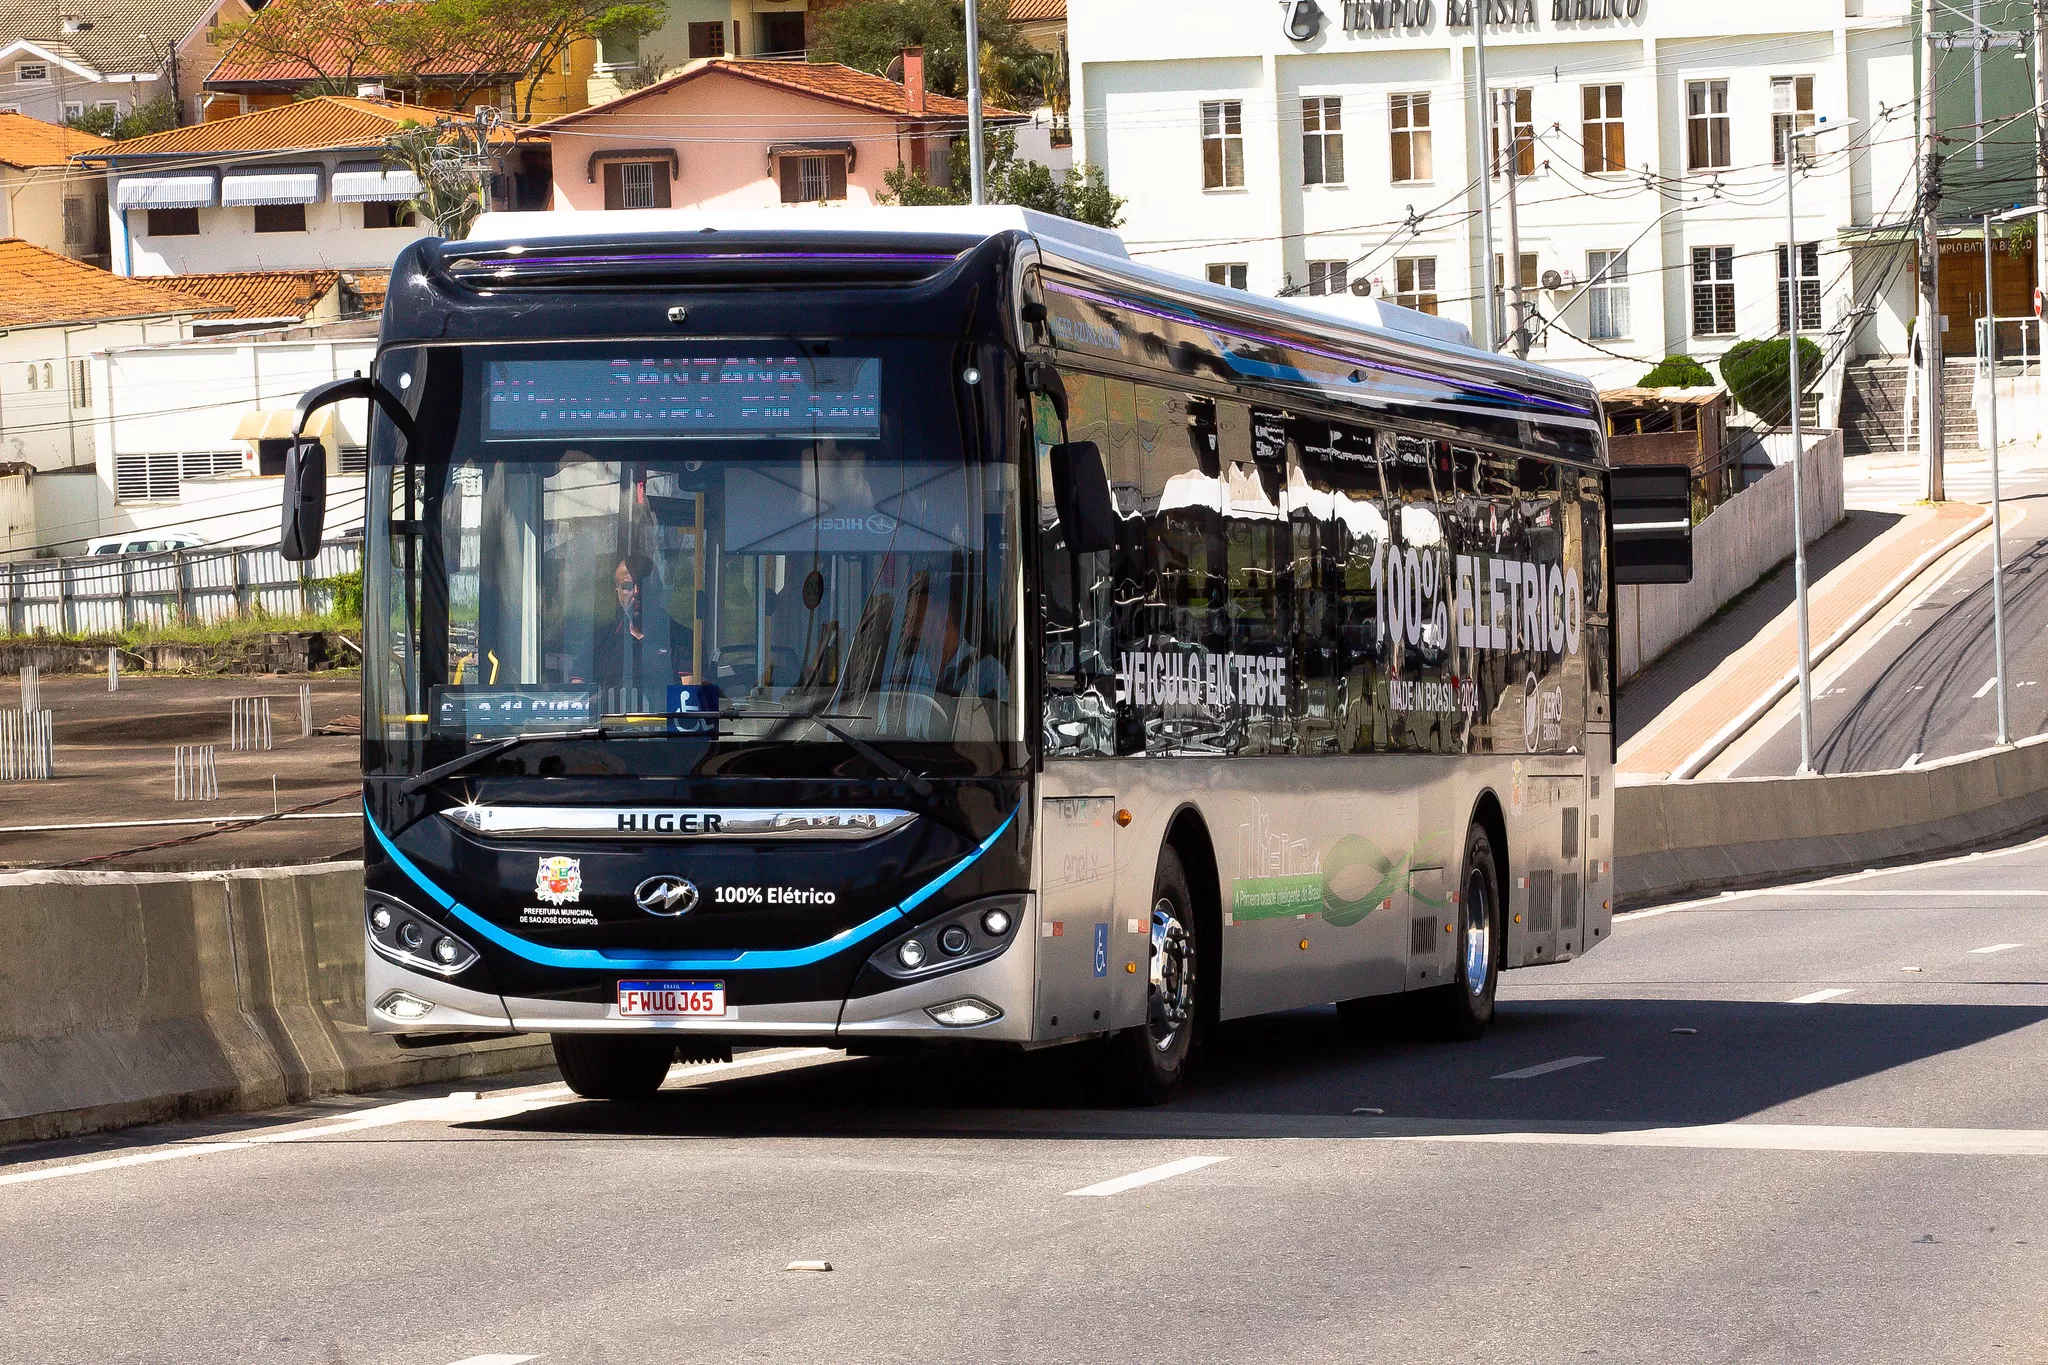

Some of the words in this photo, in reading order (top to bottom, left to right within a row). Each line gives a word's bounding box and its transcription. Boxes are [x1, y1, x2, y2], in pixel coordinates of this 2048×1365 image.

[1341, 0, 1430, 30] TEMPLO
[1446, 0, 1533, 26] BAISTA
[1370, 542, 1448, 651] 100%
[1456, 535, 1581, 655] ELÉTRICO
[1120, 634, 1201, 706] VEÍCULO
[1206, 653, 1231, 705] EM
[1235, 654, 1287, 707] TESTE
[1390, 680, 1413, 711] MADE
[1415, 682, 1424, 711] IN
[1426, 682, 1455, 712] BRASIL
[1461, 683, 1479, 712] 2024
[617, 813, 722, 833] HIGER
[714, 886, 763, 904] 100%
[767, 886, 836, 904] Elétrico
[519, 915, 528, 923] DE
[542, 916, 558, 924] JOSÉ
[558, 917, 572, 925] DOS
[572, 917, 599, 926] CAMPOS
[523, 907, 560, 916] PREFEITURA
[561, 908, 594, 917] MUNICIPAL
